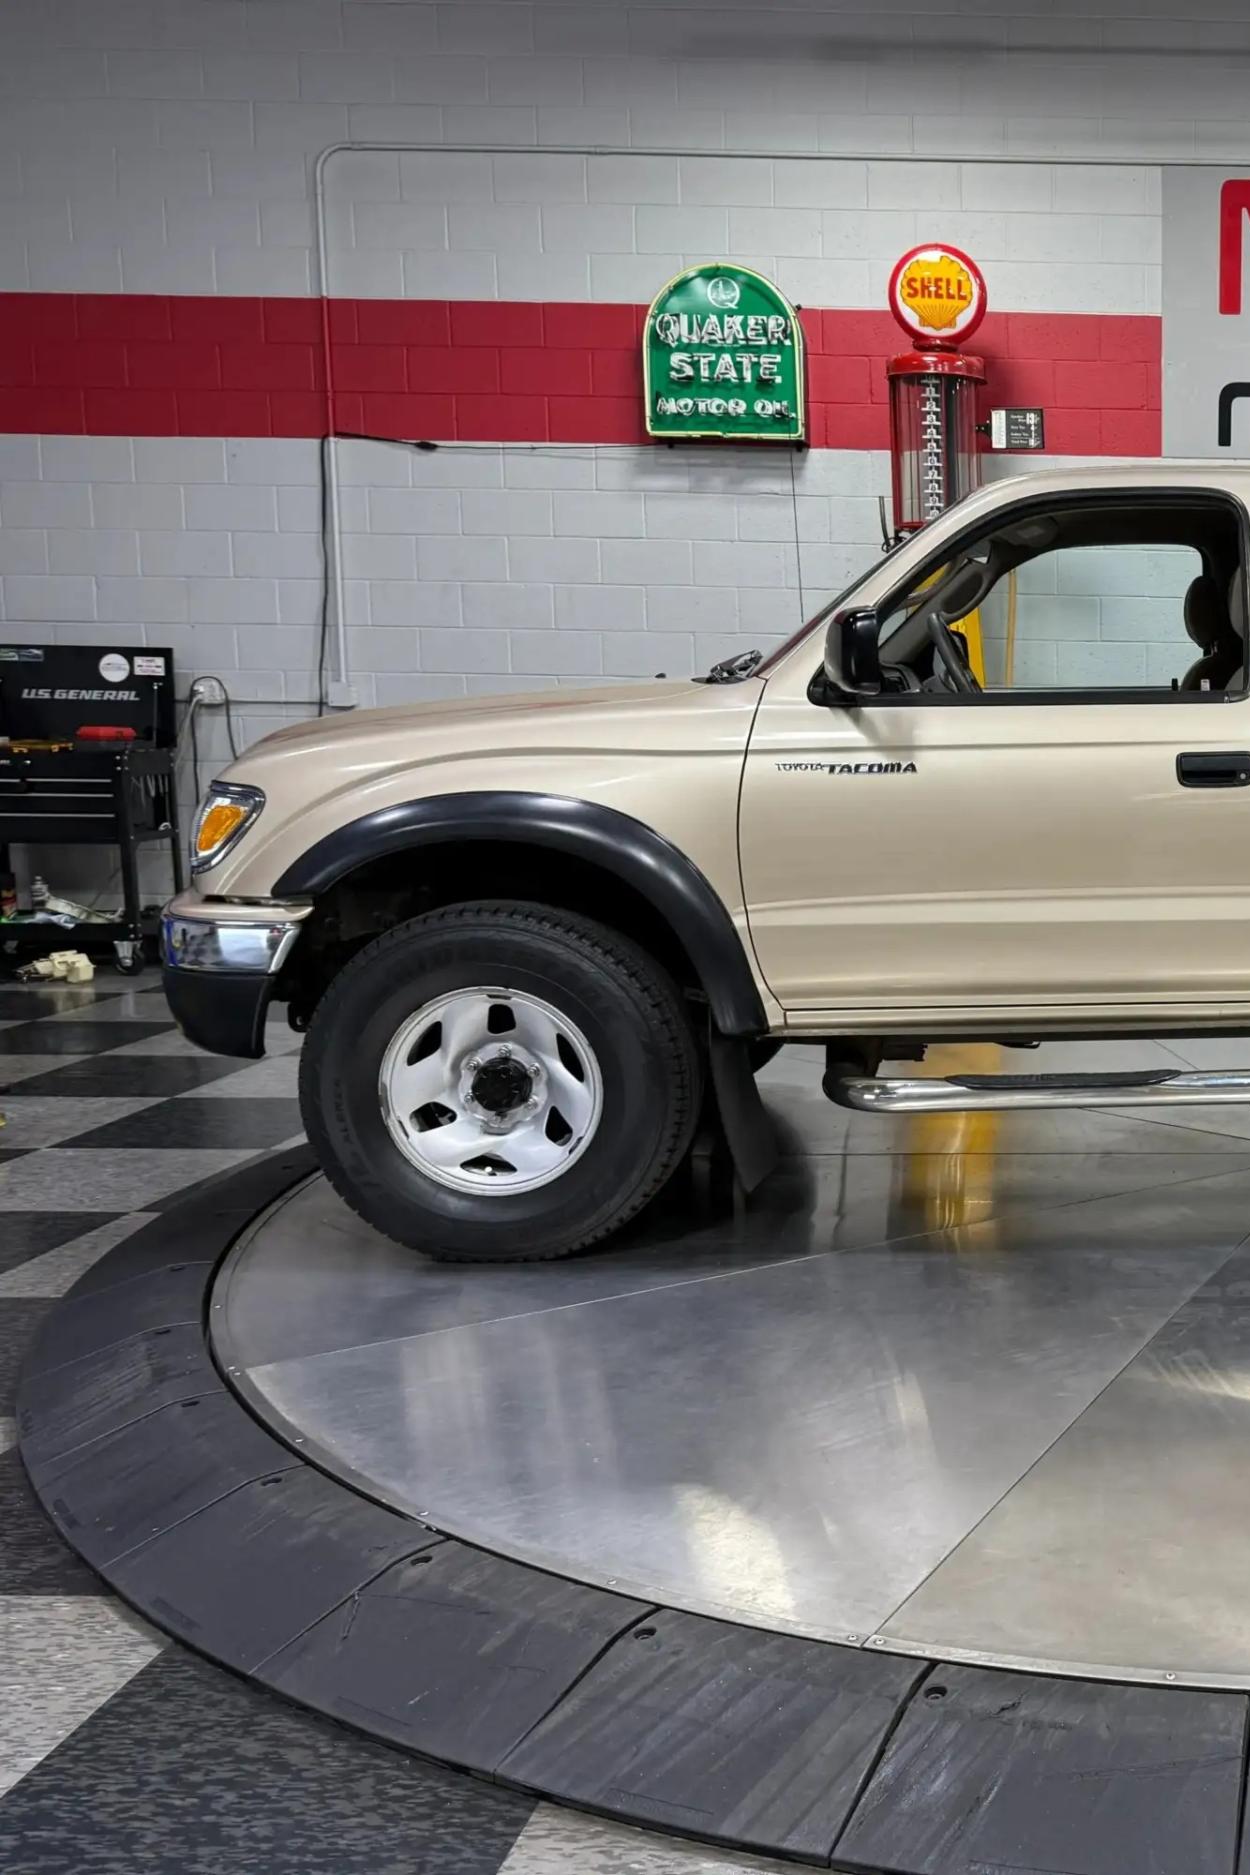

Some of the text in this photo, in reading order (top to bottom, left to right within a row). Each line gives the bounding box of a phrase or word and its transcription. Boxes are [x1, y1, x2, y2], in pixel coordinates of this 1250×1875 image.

[906, 276, 968, 301] SHELL
[655, 313, 793, 348] QUAKER
[669, 352, 783, 384] STATE
[657, 396, 747, 417] MOTOR
[53, 689, 141, 701] GENERAL
[826, 762, 918, 775] TACOMA
